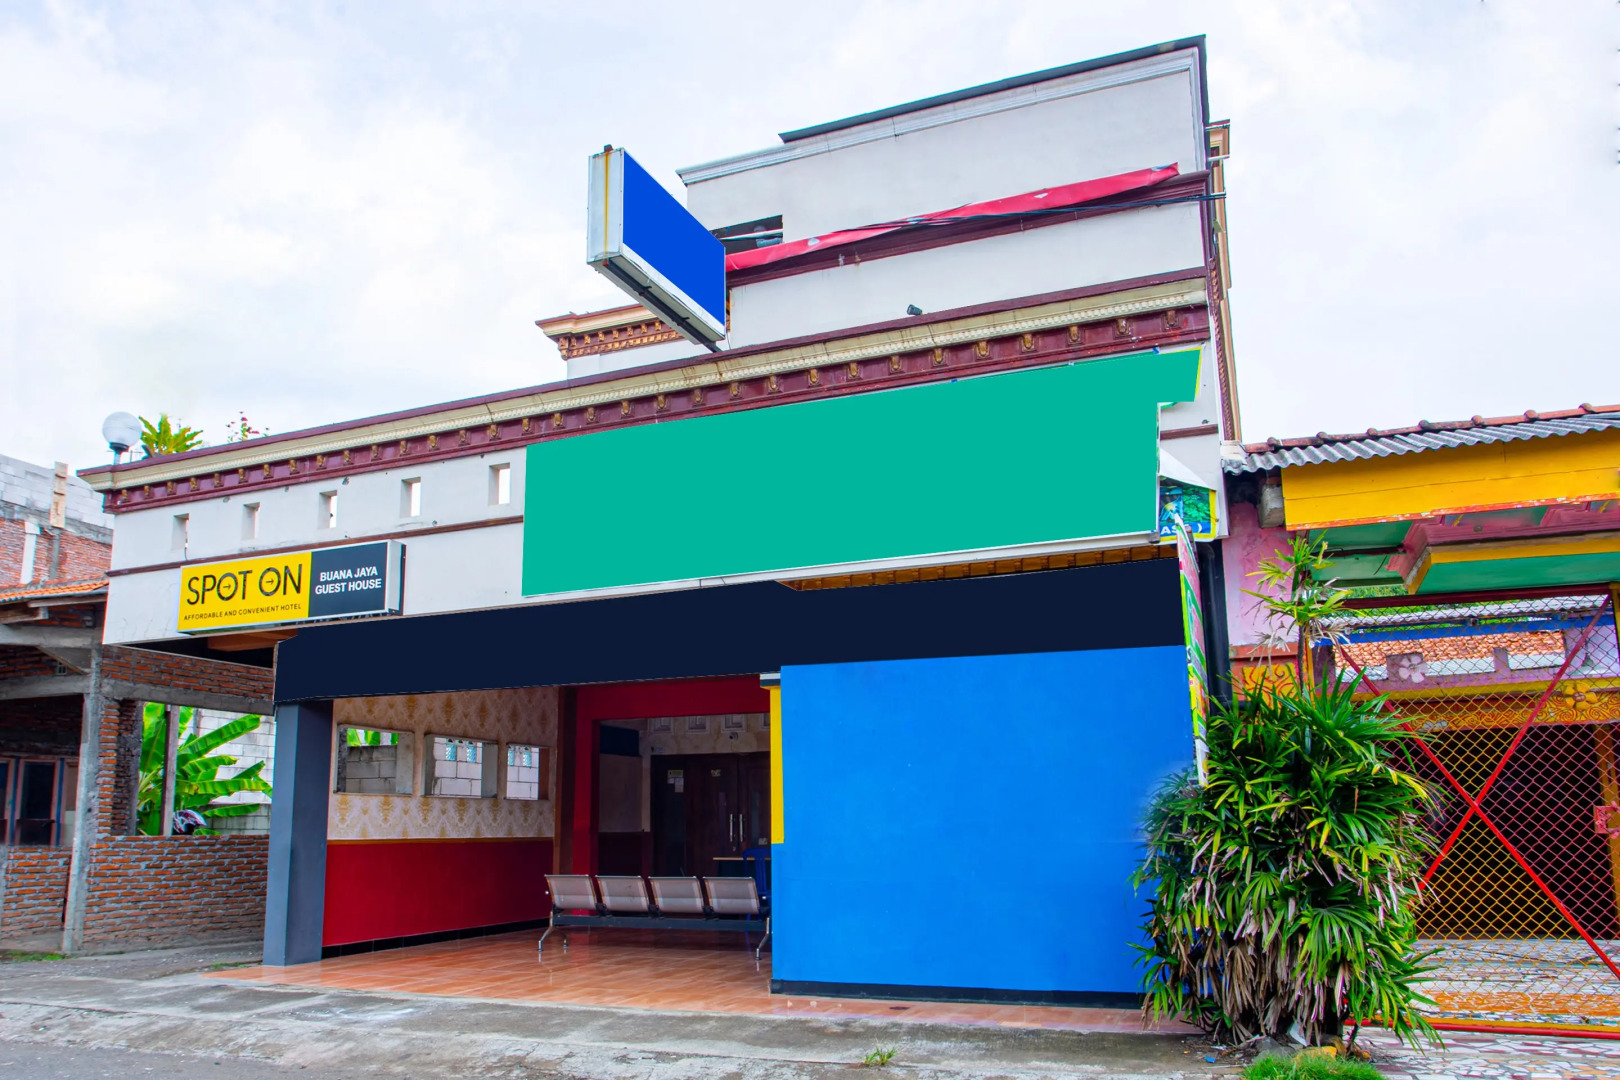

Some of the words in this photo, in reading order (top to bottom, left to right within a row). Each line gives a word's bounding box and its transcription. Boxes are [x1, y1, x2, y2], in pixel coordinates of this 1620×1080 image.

[320, 568, 353, 582] BUANA
[354, 566, 378, 578] JAYA
[187, 569, 253, 606] SPOT
[259, 564, 303, 597] ON
[315, 582, 347, 595] GUEST
[348, 578, 382, 592] HOUSE
[184, 611, 223, 621] AFFORDABLE
[224, 609, 237, 617] AND
[238, 605, 279, 616] CONVENIENT
[280, 603, 302, 612] HOTEL
